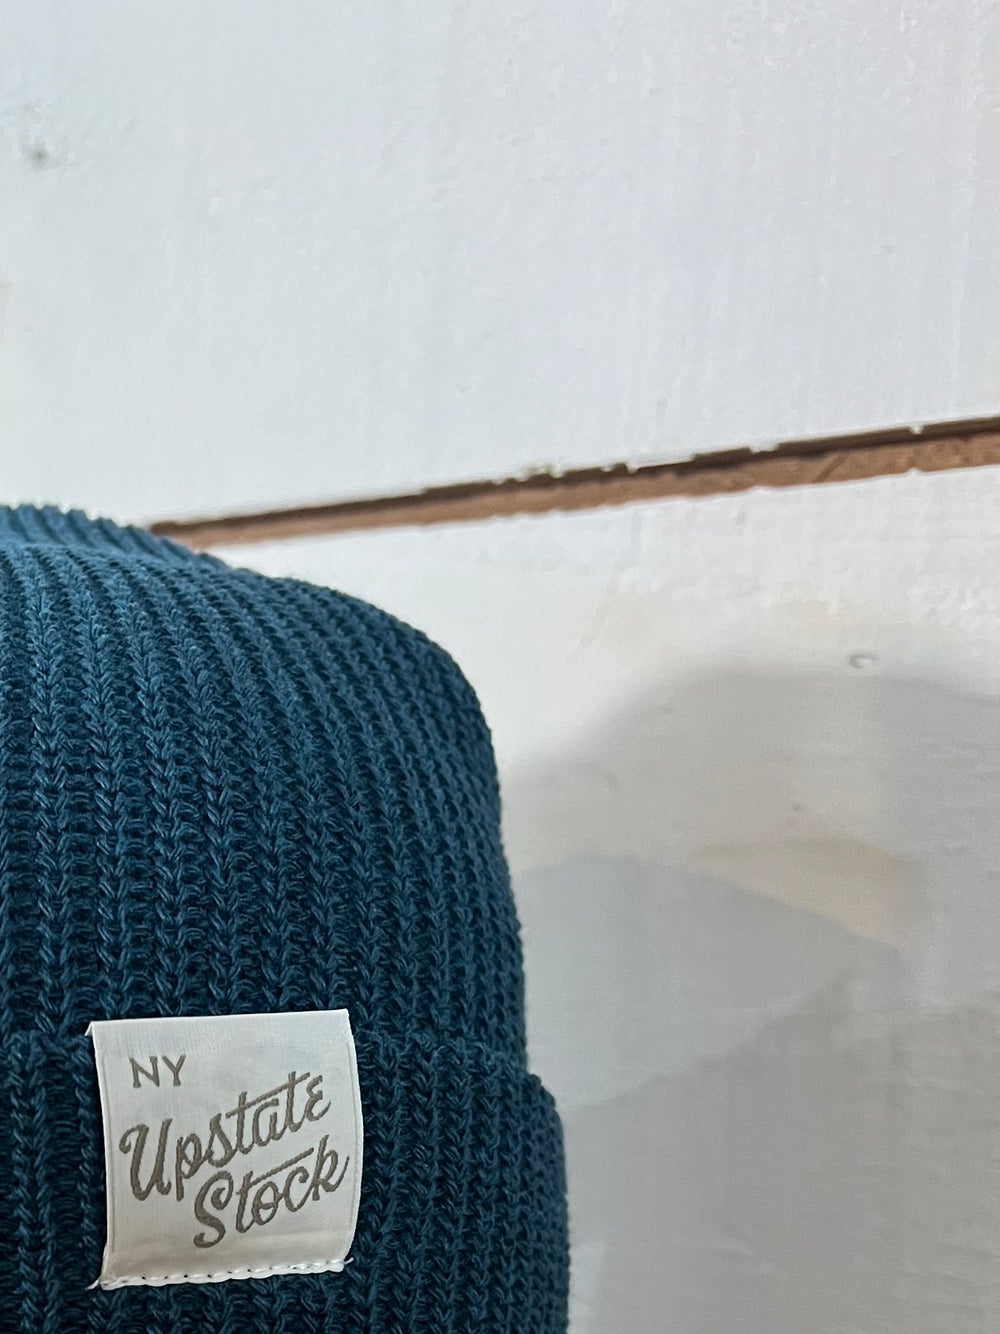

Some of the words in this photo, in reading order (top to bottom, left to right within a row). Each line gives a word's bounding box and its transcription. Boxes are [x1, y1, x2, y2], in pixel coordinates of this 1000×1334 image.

[129, 1054, 187, 1089] NY
[118, 1071, 332, 1202] Upstate
[193, 1134, 350, 1248] Stock
